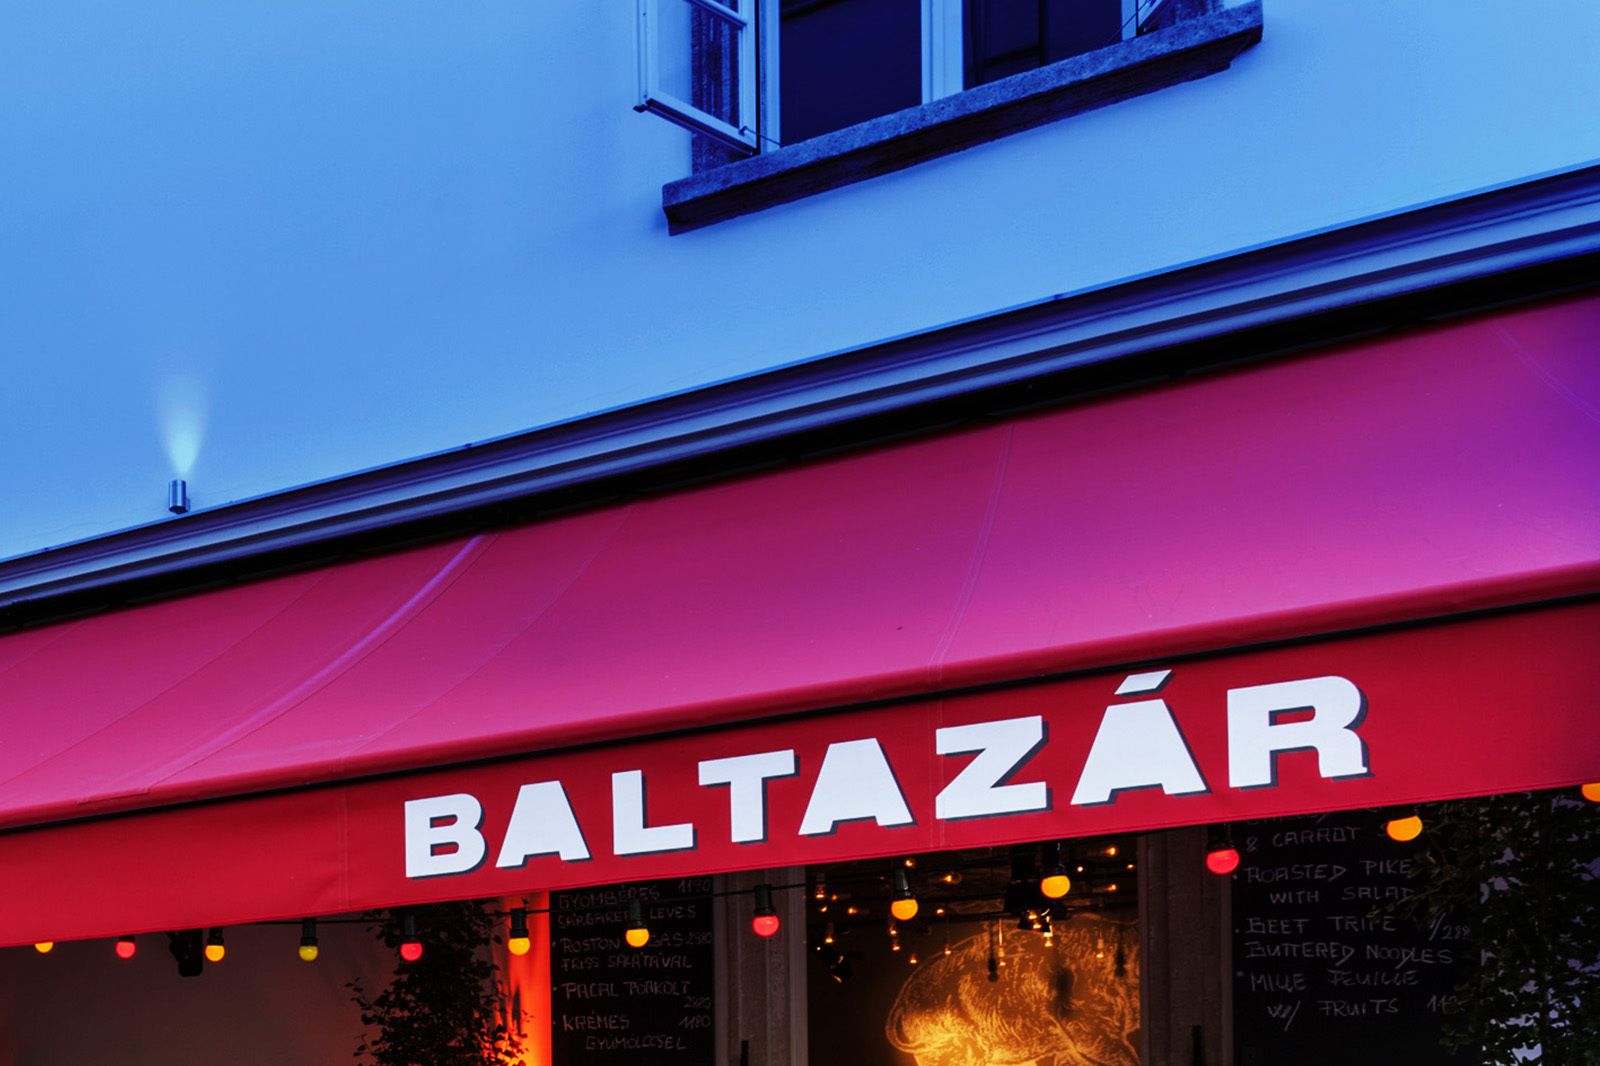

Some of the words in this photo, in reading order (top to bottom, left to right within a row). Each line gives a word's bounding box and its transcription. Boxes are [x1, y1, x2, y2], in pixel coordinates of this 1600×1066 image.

[404, 670, 1370, 880] BALTAZÁR
[1272, 827, 1360, 848] CARROT
[1246, 864, 1347, 883] ROASTED
[1359, 858, 1413, 876] PIKE
[1269, 889, 1320, 905] WITH
[649, 904, 697, 920] LEVES
[560, 937, 622, 953] ROSTON
[1245, 940, 1355, 966] BUTTERED
[1366, 945, 1455, 969] NOODLES
[560, 956, 600, 972] FRISS
[1327, 969, 1420, 987] FEUILLE
[560, 982, 619, 1000] PACAL
[1317, 999, 1399, 1017] FRUITS
[561, 1010, 631, 1031] KRÉMES
